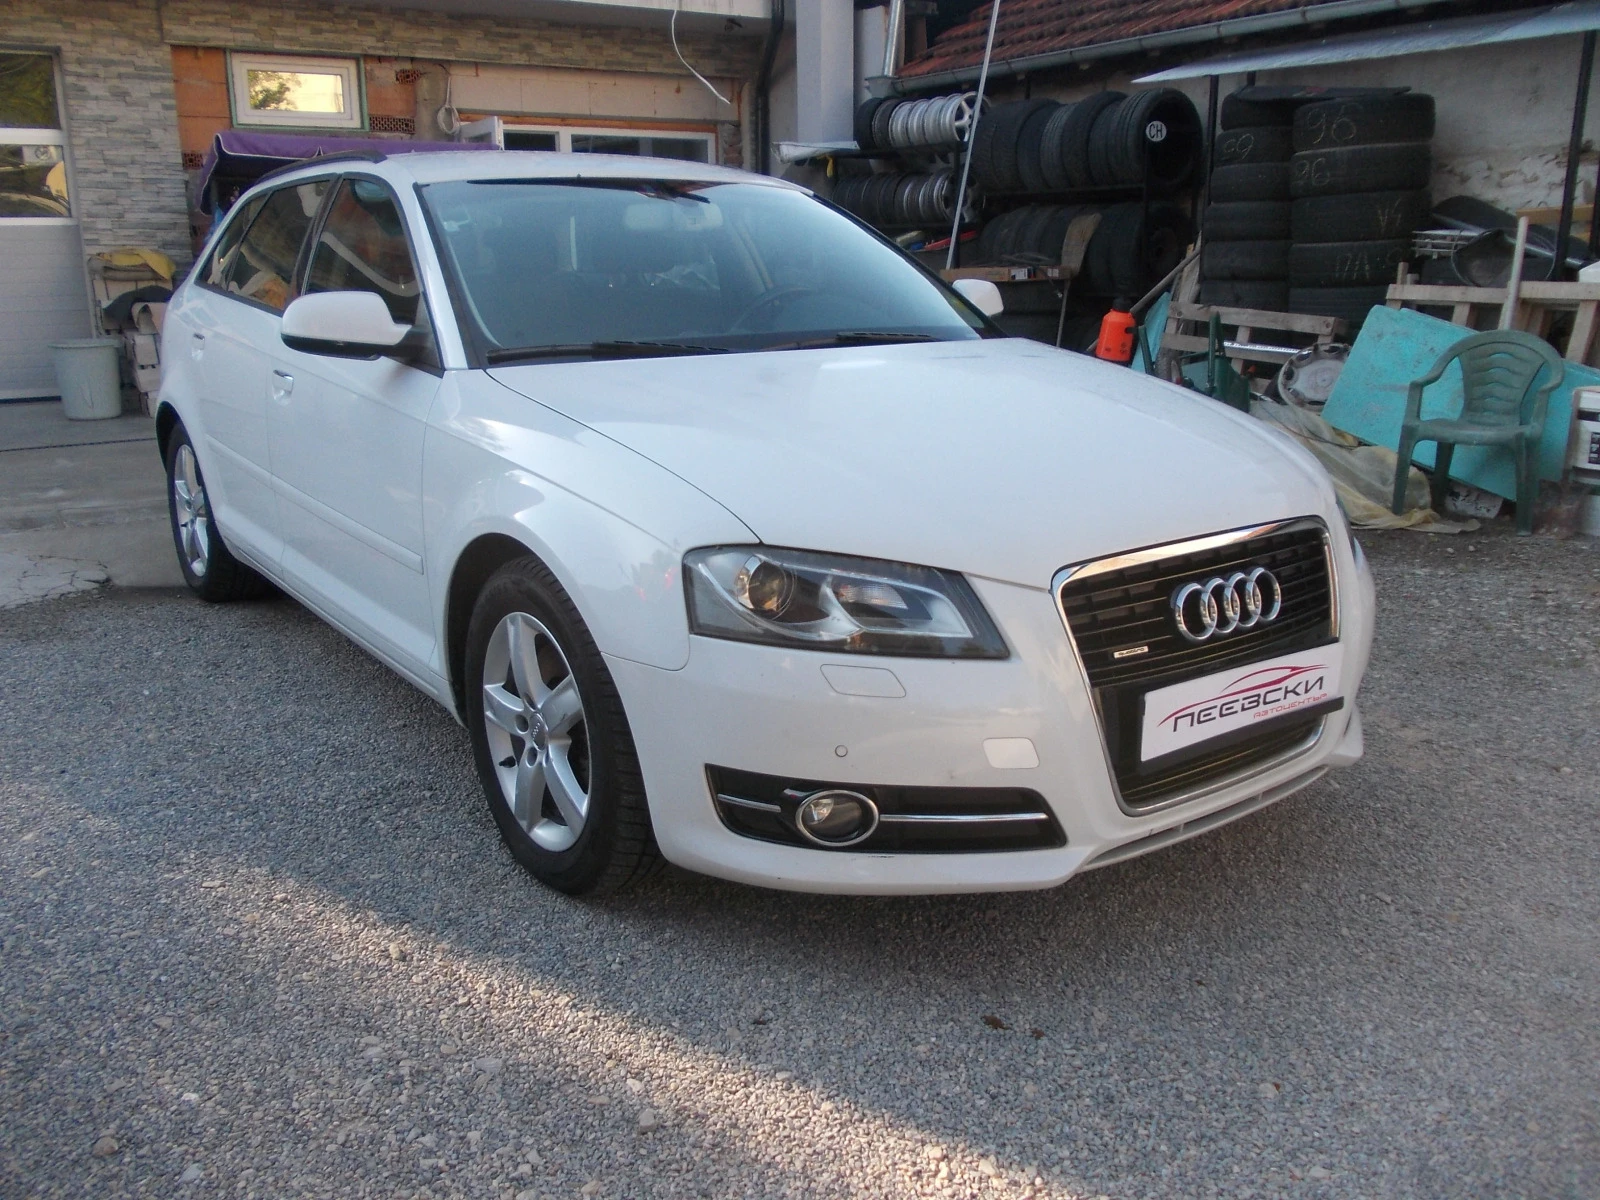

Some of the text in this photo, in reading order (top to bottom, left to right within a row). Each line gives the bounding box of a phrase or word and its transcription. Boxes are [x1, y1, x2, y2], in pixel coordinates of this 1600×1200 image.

[1149, 123, 1163, 139] CH
[1307, 102, 1359, 144] 96
[1172, 675, 1325, 732] ПЕЕВСКИ
